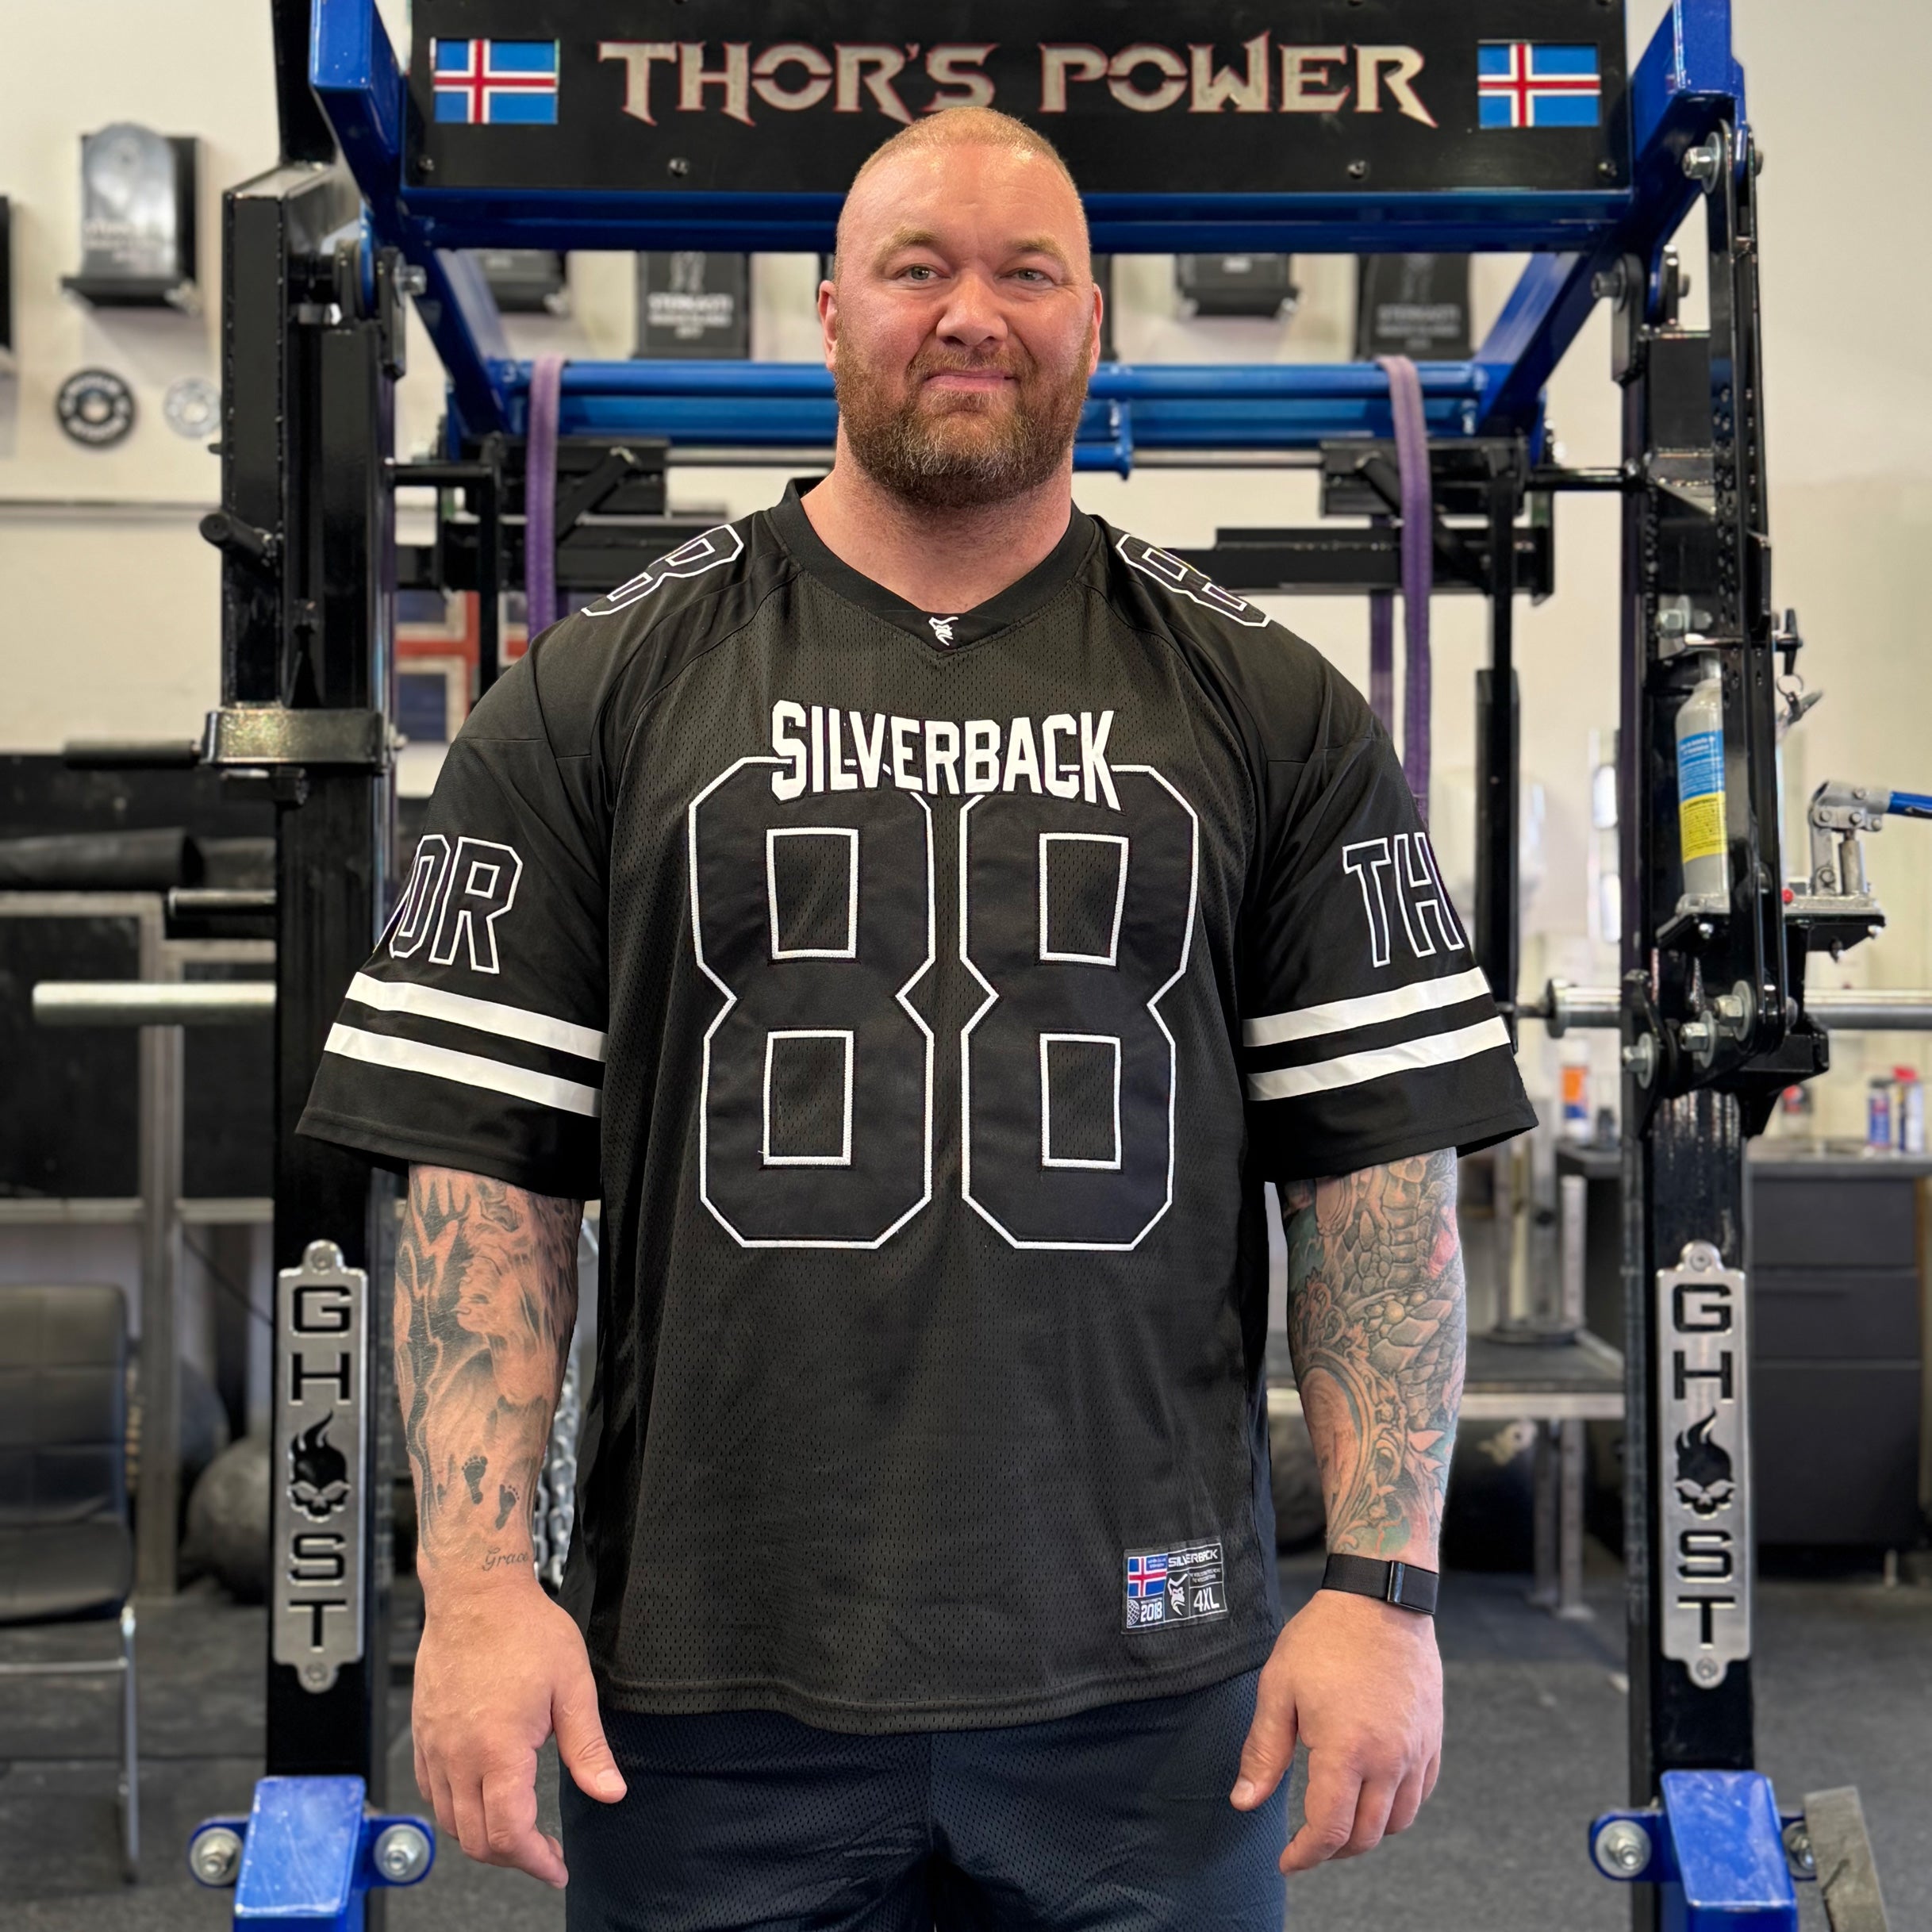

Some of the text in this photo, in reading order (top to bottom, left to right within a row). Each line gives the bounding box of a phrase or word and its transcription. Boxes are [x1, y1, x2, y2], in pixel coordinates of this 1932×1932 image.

[598, 30, 1438, 129] THOR'S POWER
[770, 699, 1121, 812] SILVERBACK
[373, 834, 524, 974] OR
[1342, 832, 1465, 968] TH
[688, 756, 1199, 1251] 88
[1168, 1548, 1219, 1568] SILVERBACK
[1193, 1586, 1220, 1612] 4XL
[1140, 1600, 1163, 1623] 2018
